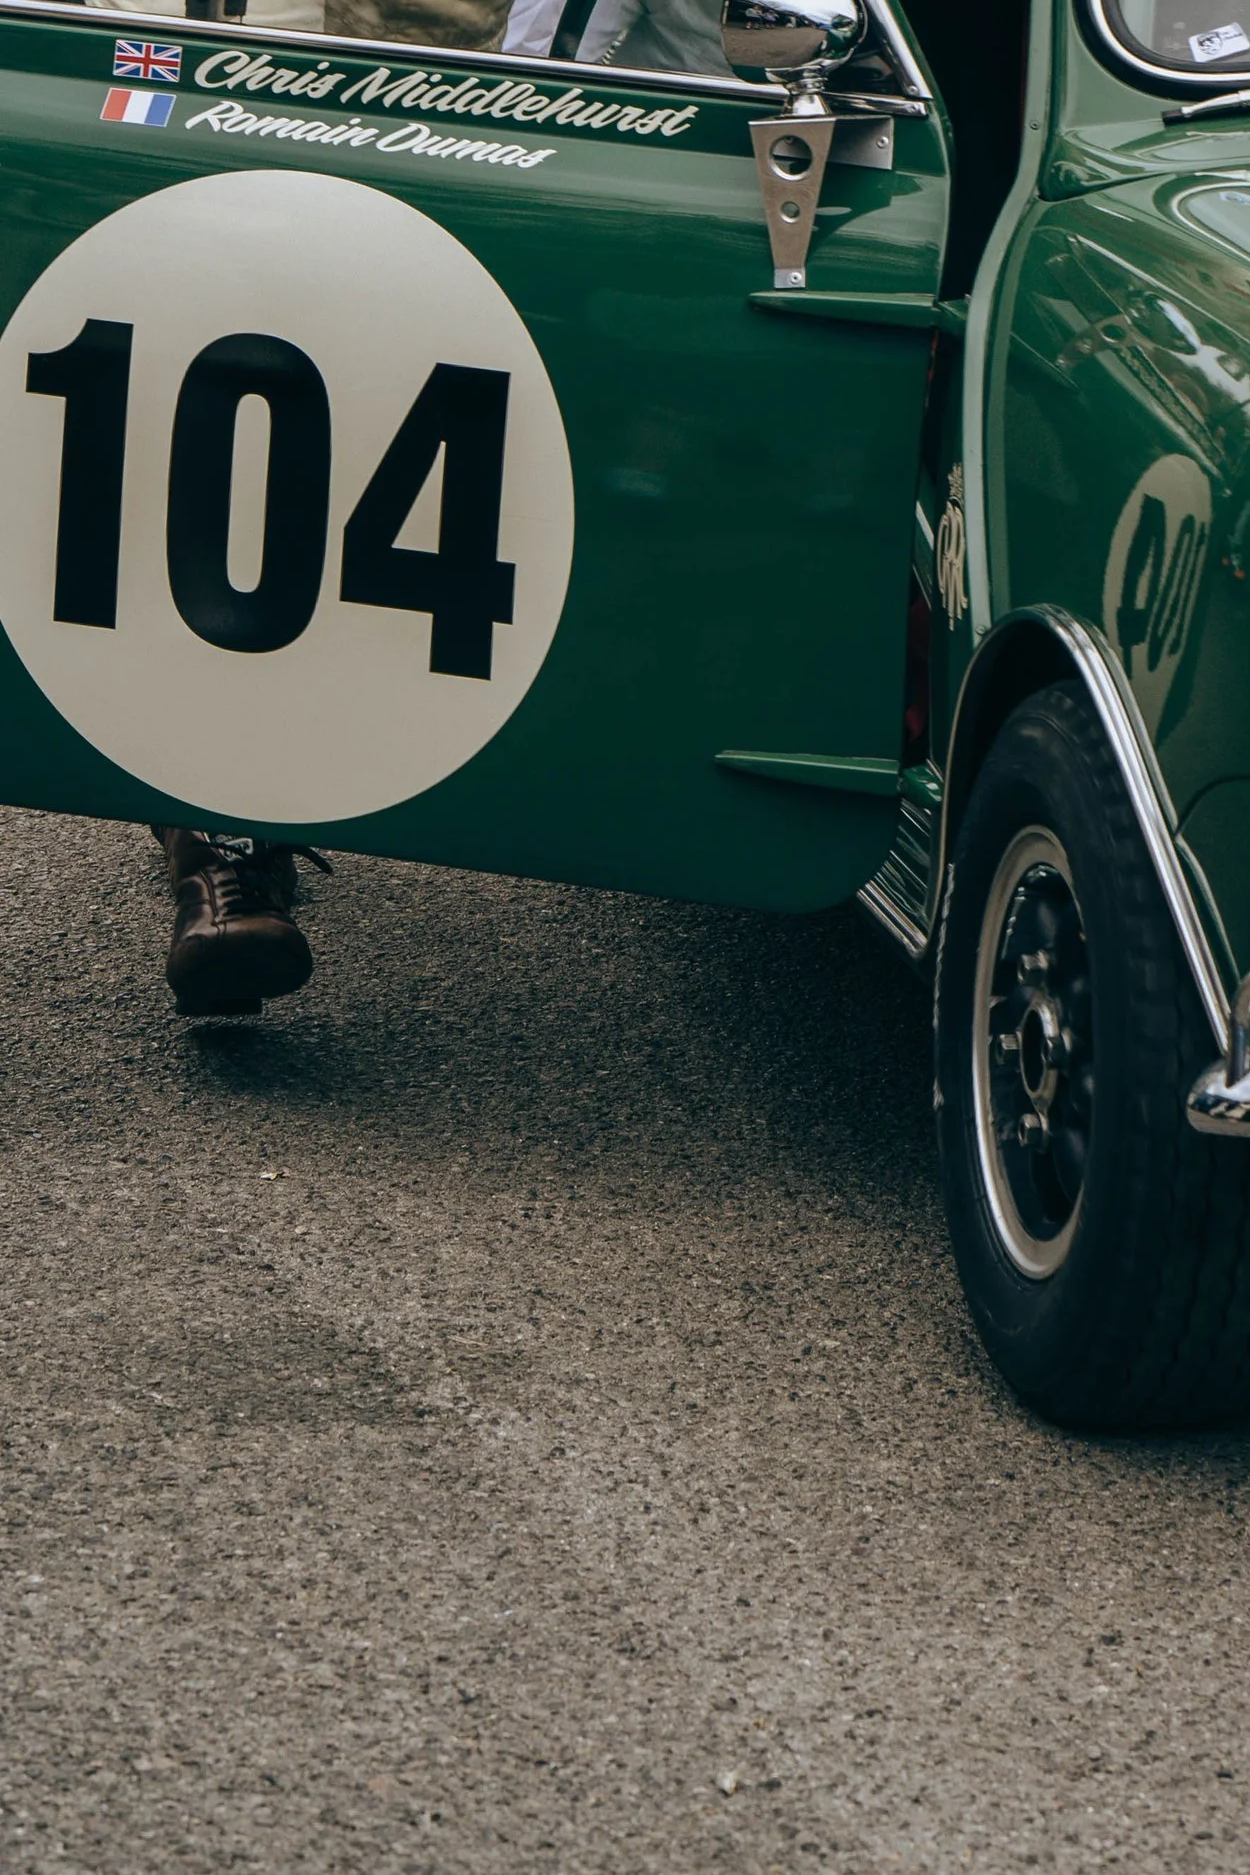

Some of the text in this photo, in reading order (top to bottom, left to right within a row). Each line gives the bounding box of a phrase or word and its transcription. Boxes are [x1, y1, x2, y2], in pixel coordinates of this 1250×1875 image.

[185, 100, 558, 169] Romain Dumas
[194, 50, 700, 137] Chris Middlehurst
[26, 318, 516, 681] 104
